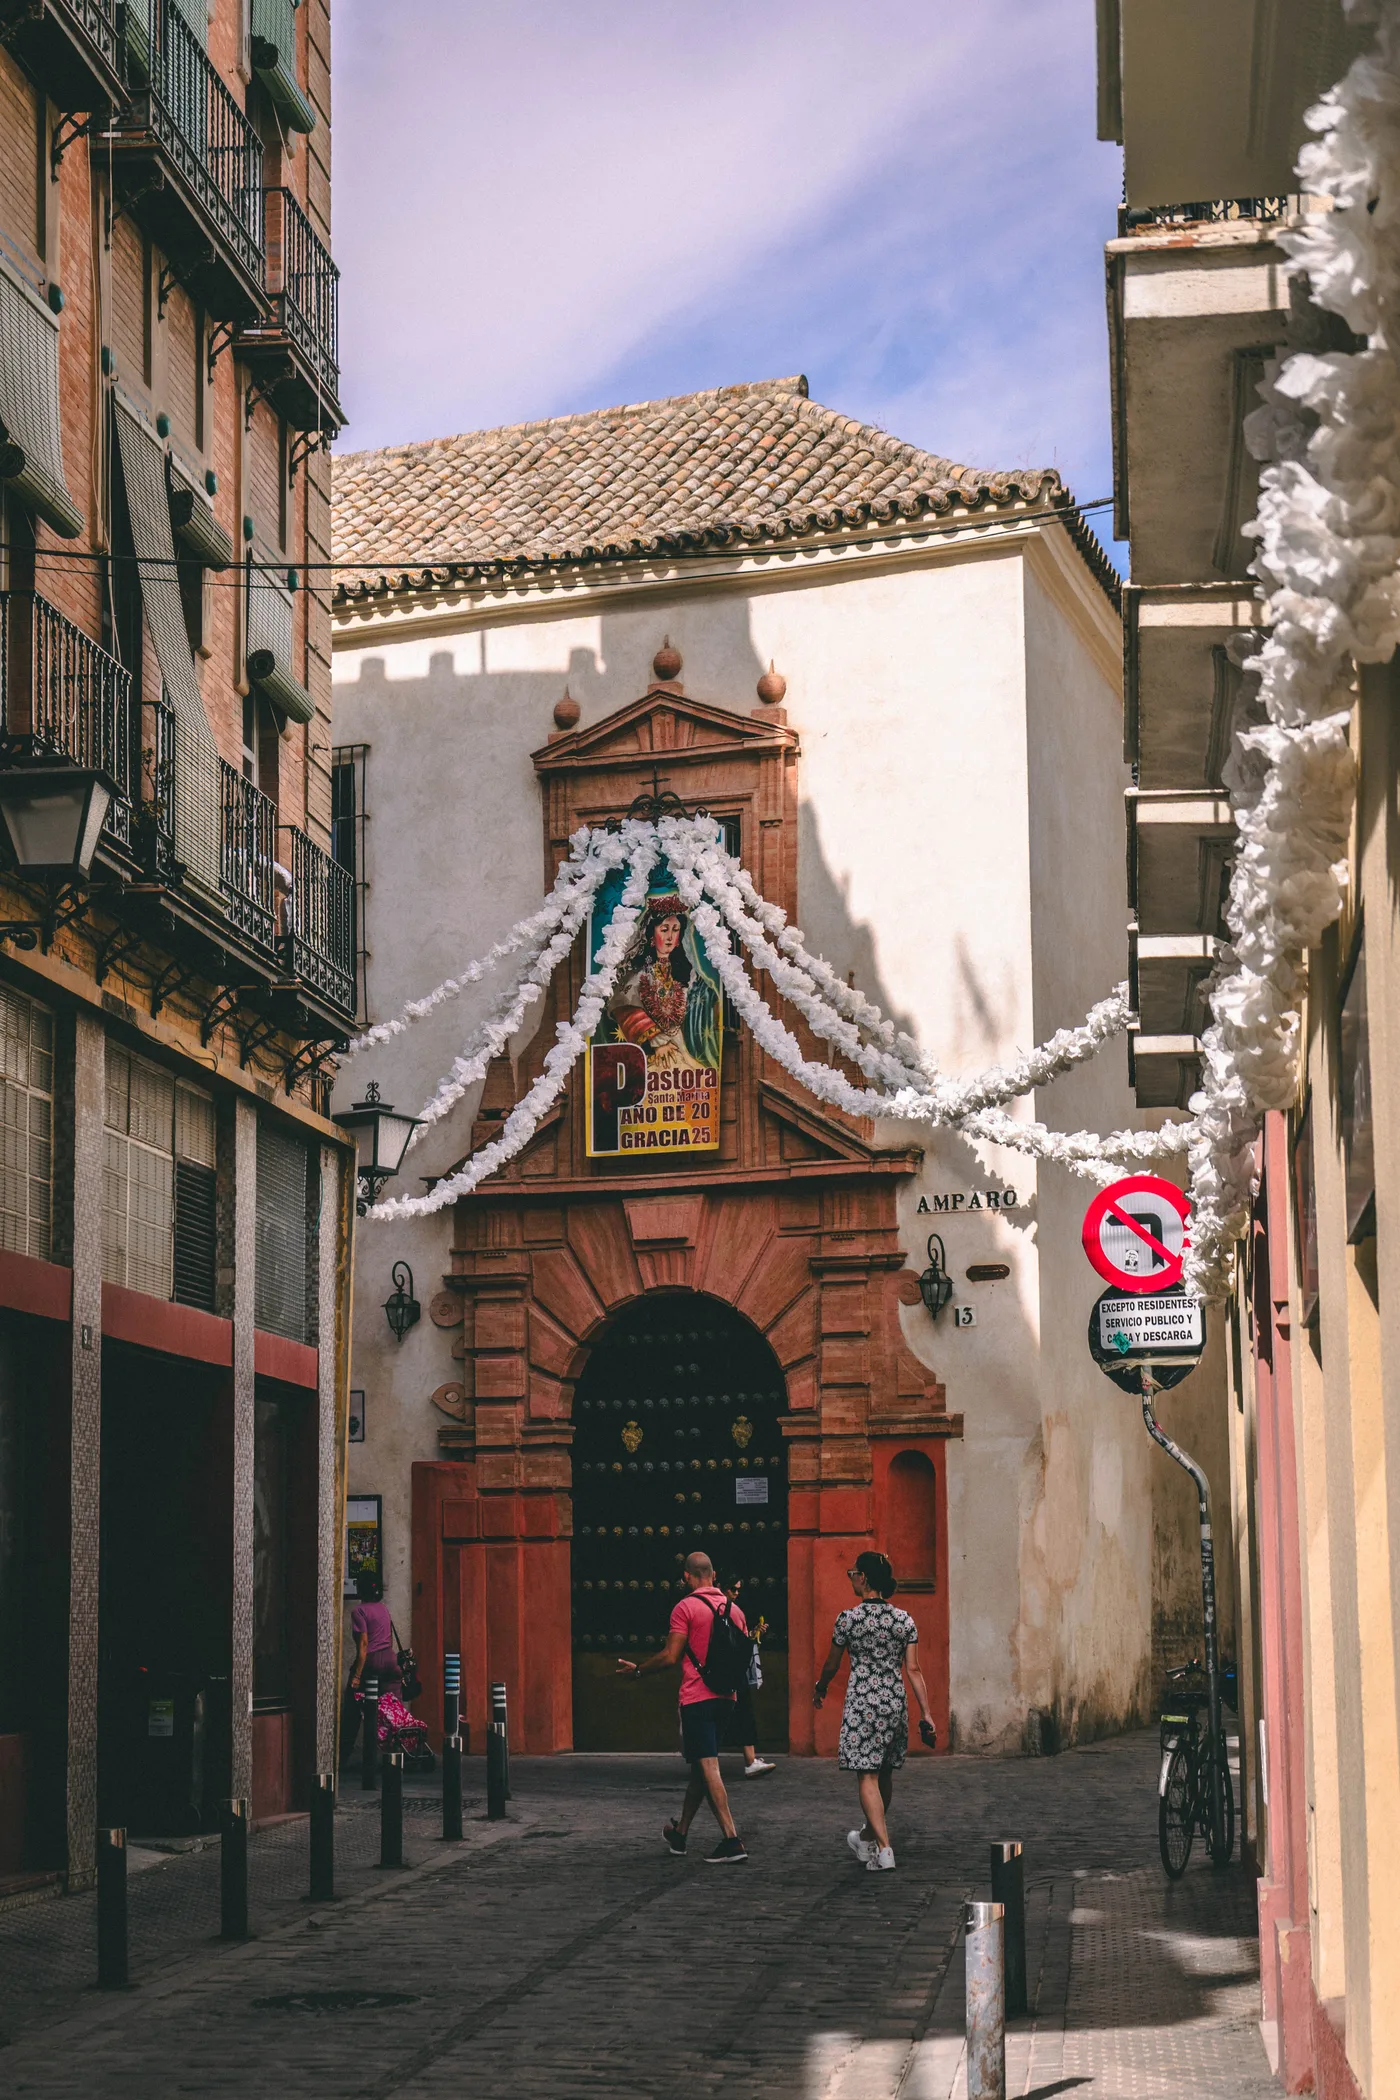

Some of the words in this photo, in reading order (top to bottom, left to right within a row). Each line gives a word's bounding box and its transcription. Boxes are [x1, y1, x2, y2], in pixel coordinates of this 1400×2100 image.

[591, 1043, 717, 1153] Pastora
[648, 1092, 675, 1104] Santa
[621, 1105, 657, 1125] AÑO
[662, 1105, 685, 1121] DE
[692, 1102, 710, 1119] 20
[621, 1129, 690, 1149] GRACIA
[692, 1127, 710, 1144] 25
[917, 1190, 1017, 1213] AMPARO
[1102, 1301, 1135, 1313] EXCEPTO
[1106, 1317, 1142, 1328] SERVICIO
[1145, 1315, 1184, 1326] PUBLICO
[1187, 1314, 1193, 1324] Y
[1107, 1332, 1134, 1343] CGA
[1135, 1332, 1141, 1342] Y
[1143, 1330, 1193, 1341] DESCARGA
